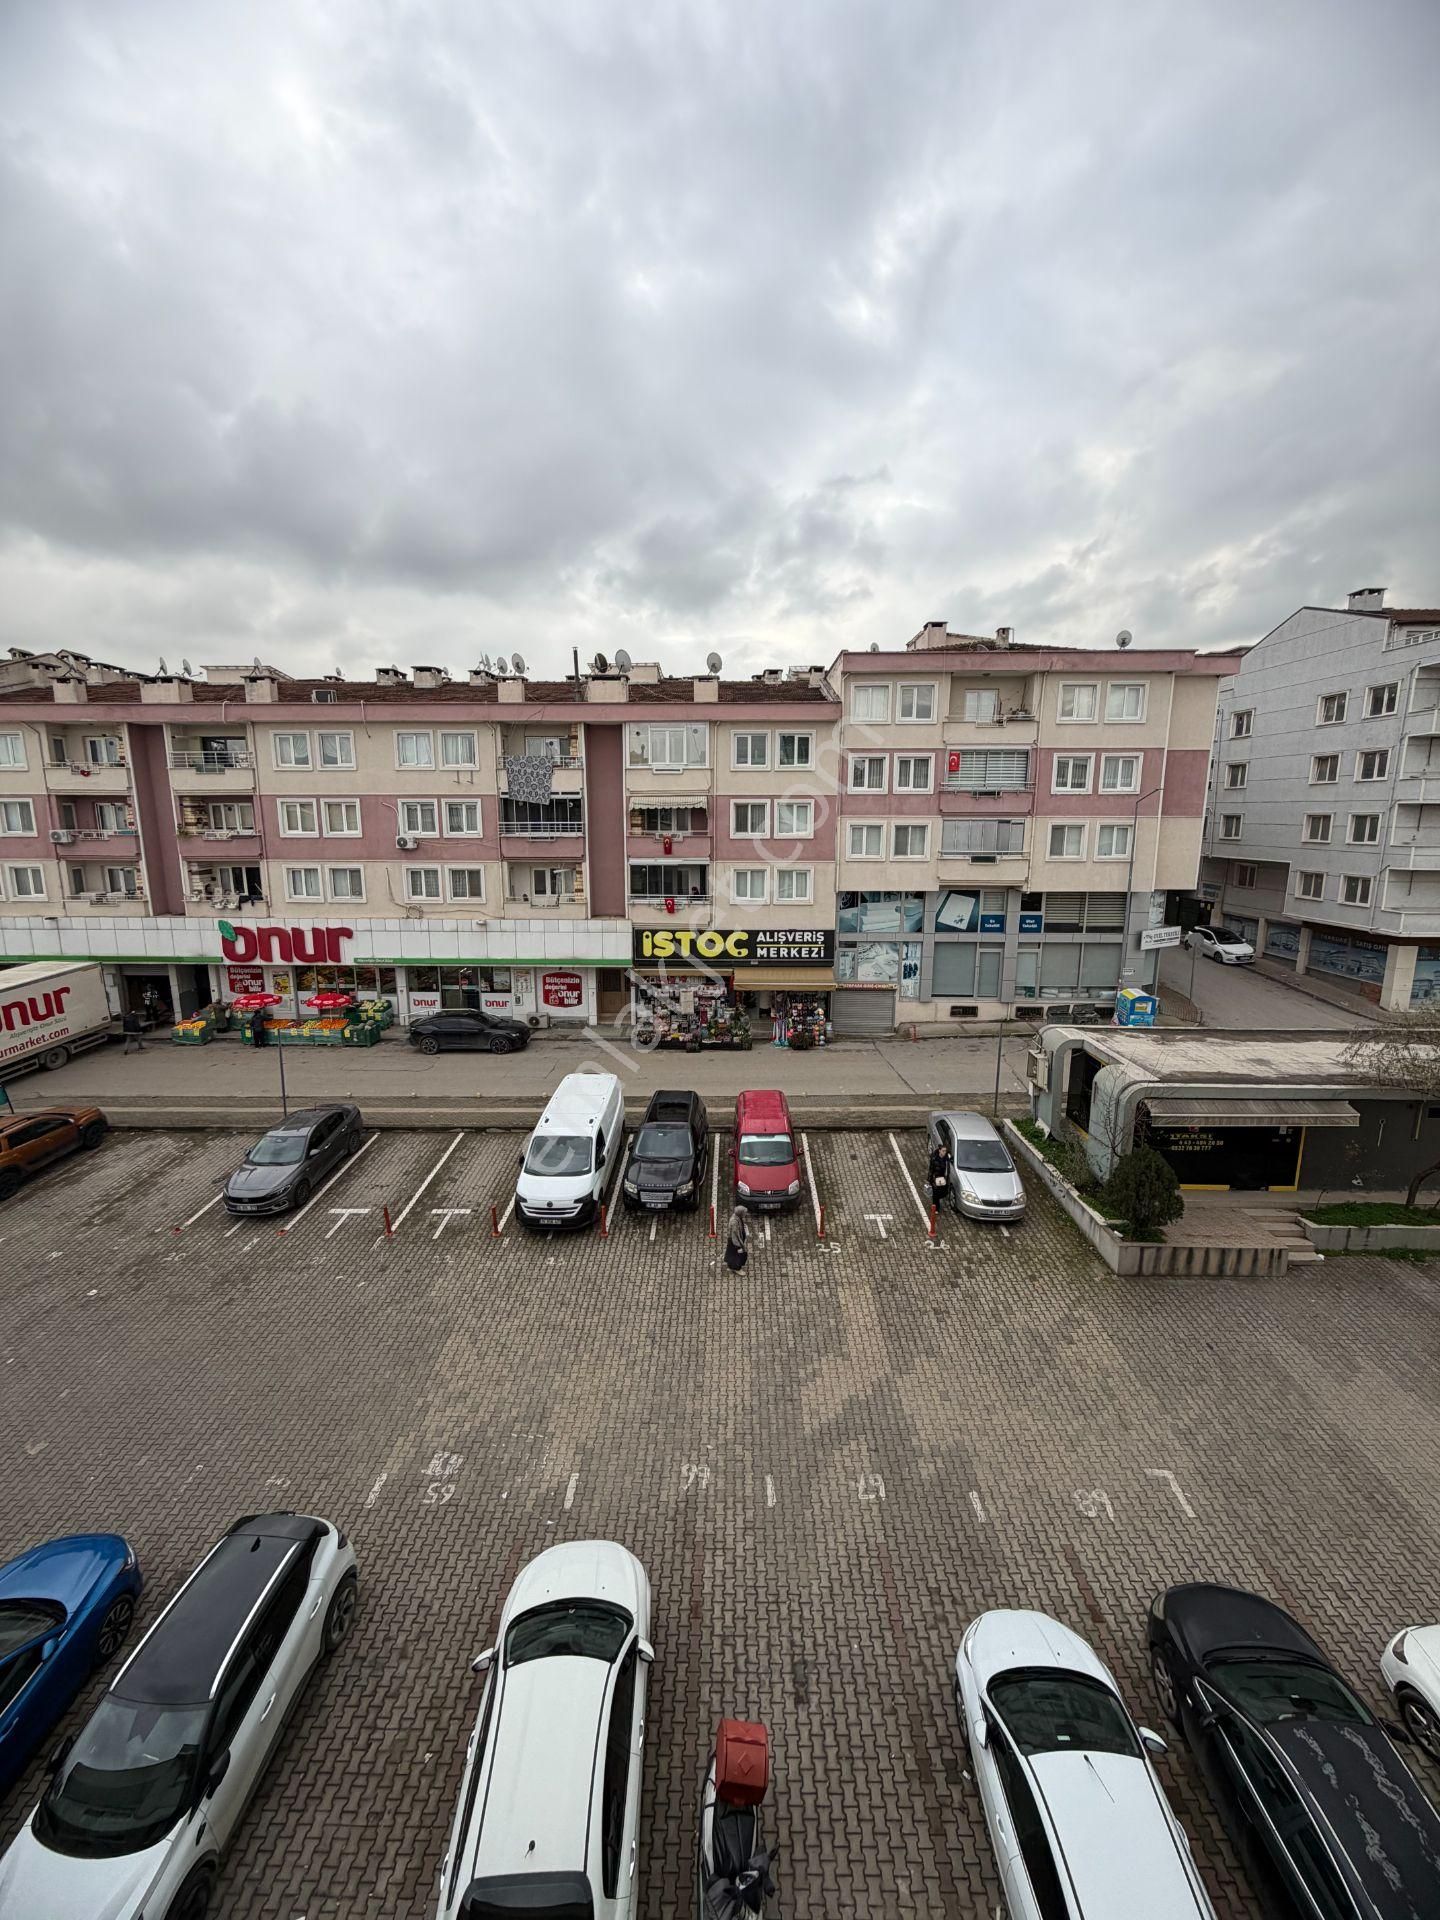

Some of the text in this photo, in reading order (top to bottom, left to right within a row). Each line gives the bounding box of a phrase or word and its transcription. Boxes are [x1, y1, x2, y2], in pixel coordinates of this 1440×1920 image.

[756, 931, 825, 944] ALIŞVERİŞ
[221, 926, 353, 963] onur
[756, 946, 825, 958] MERKEZİ
[557, 990, 581, 998] onur
[412, 997, 439, 1008] onur
[484, 998, 510, 1008] onur
[0, 986, 70, 1033] nur
[815, 1242, 842, 1253] 25
